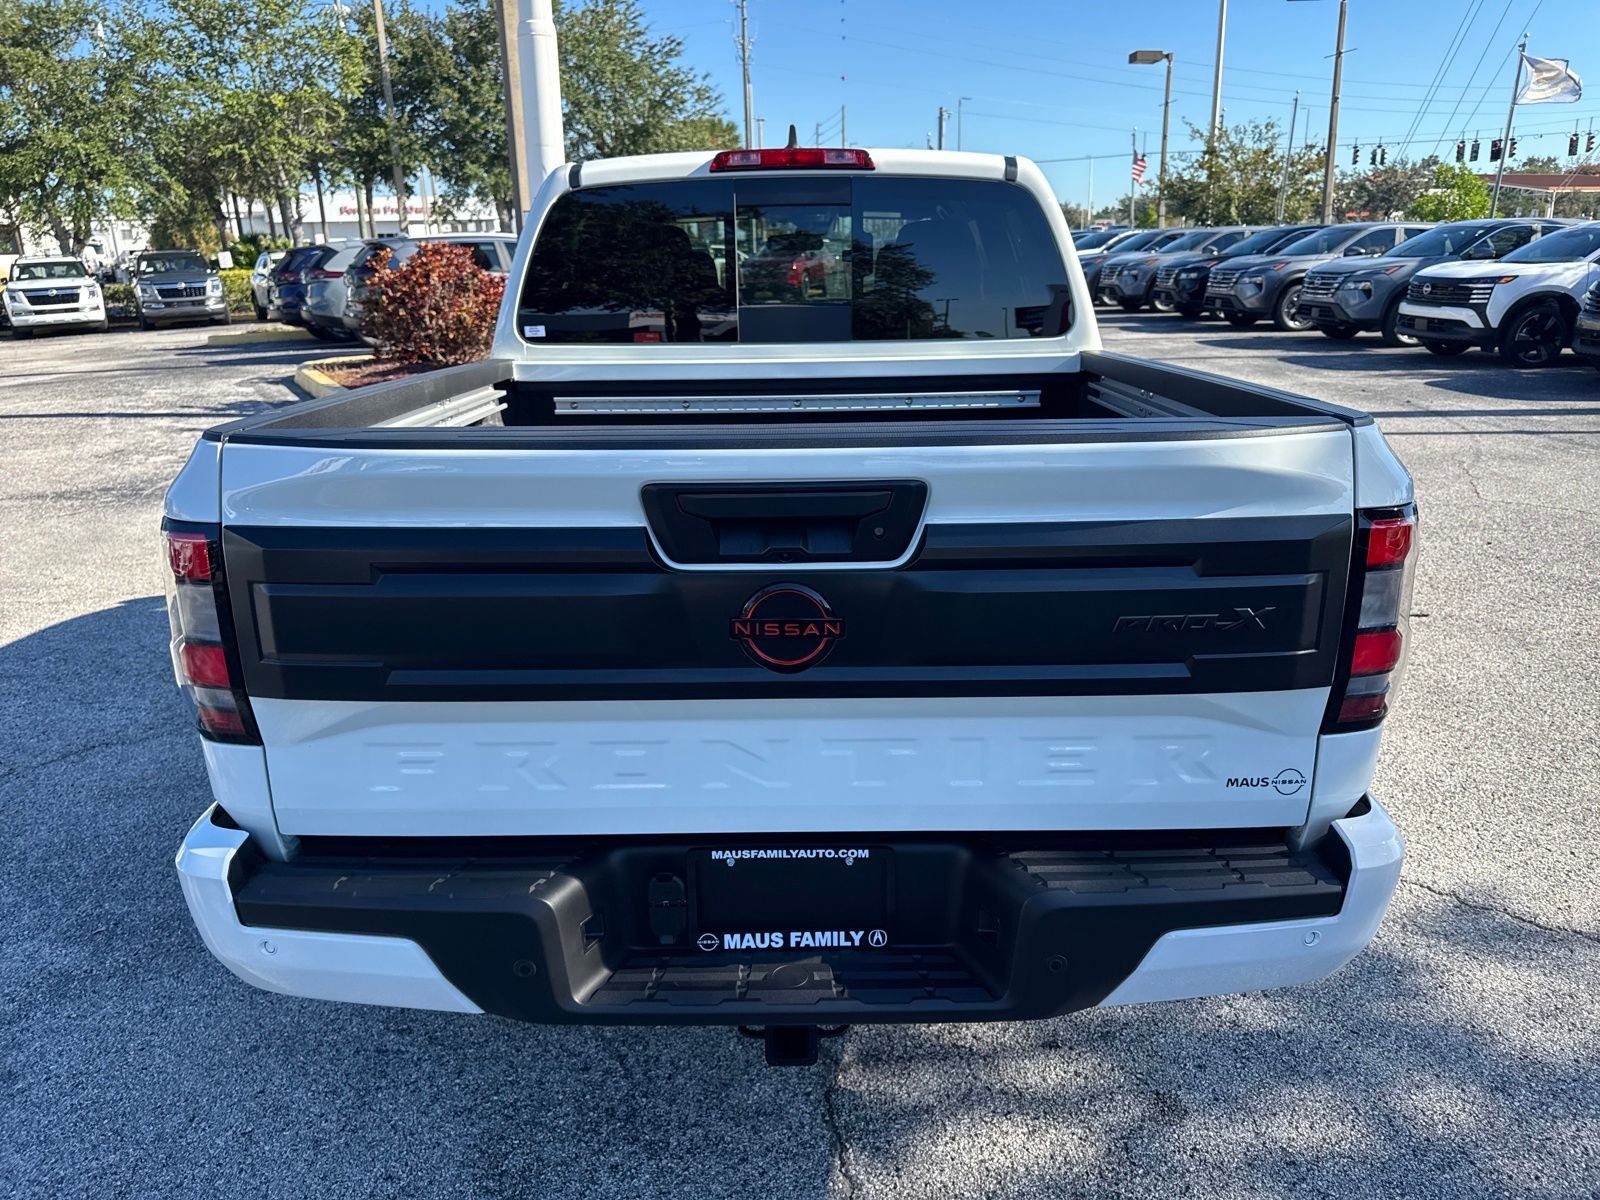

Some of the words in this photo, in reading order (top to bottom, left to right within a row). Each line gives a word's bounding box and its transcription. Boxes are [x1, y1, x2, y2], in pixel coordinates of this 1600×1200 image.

[1112, 606, 1277, 633] PRO-X
[734, 621, 841, 636] NISSAN
[362, 734, 1218, 792] FRONTIER
[1226, 777, 1270, 788] MAUS
[711, 849, 869, 860] MAUSFAMILYAUTO.COM
[723, 932, 784, 949] MAUS
[790, 930, 864, 947] FAMILY
